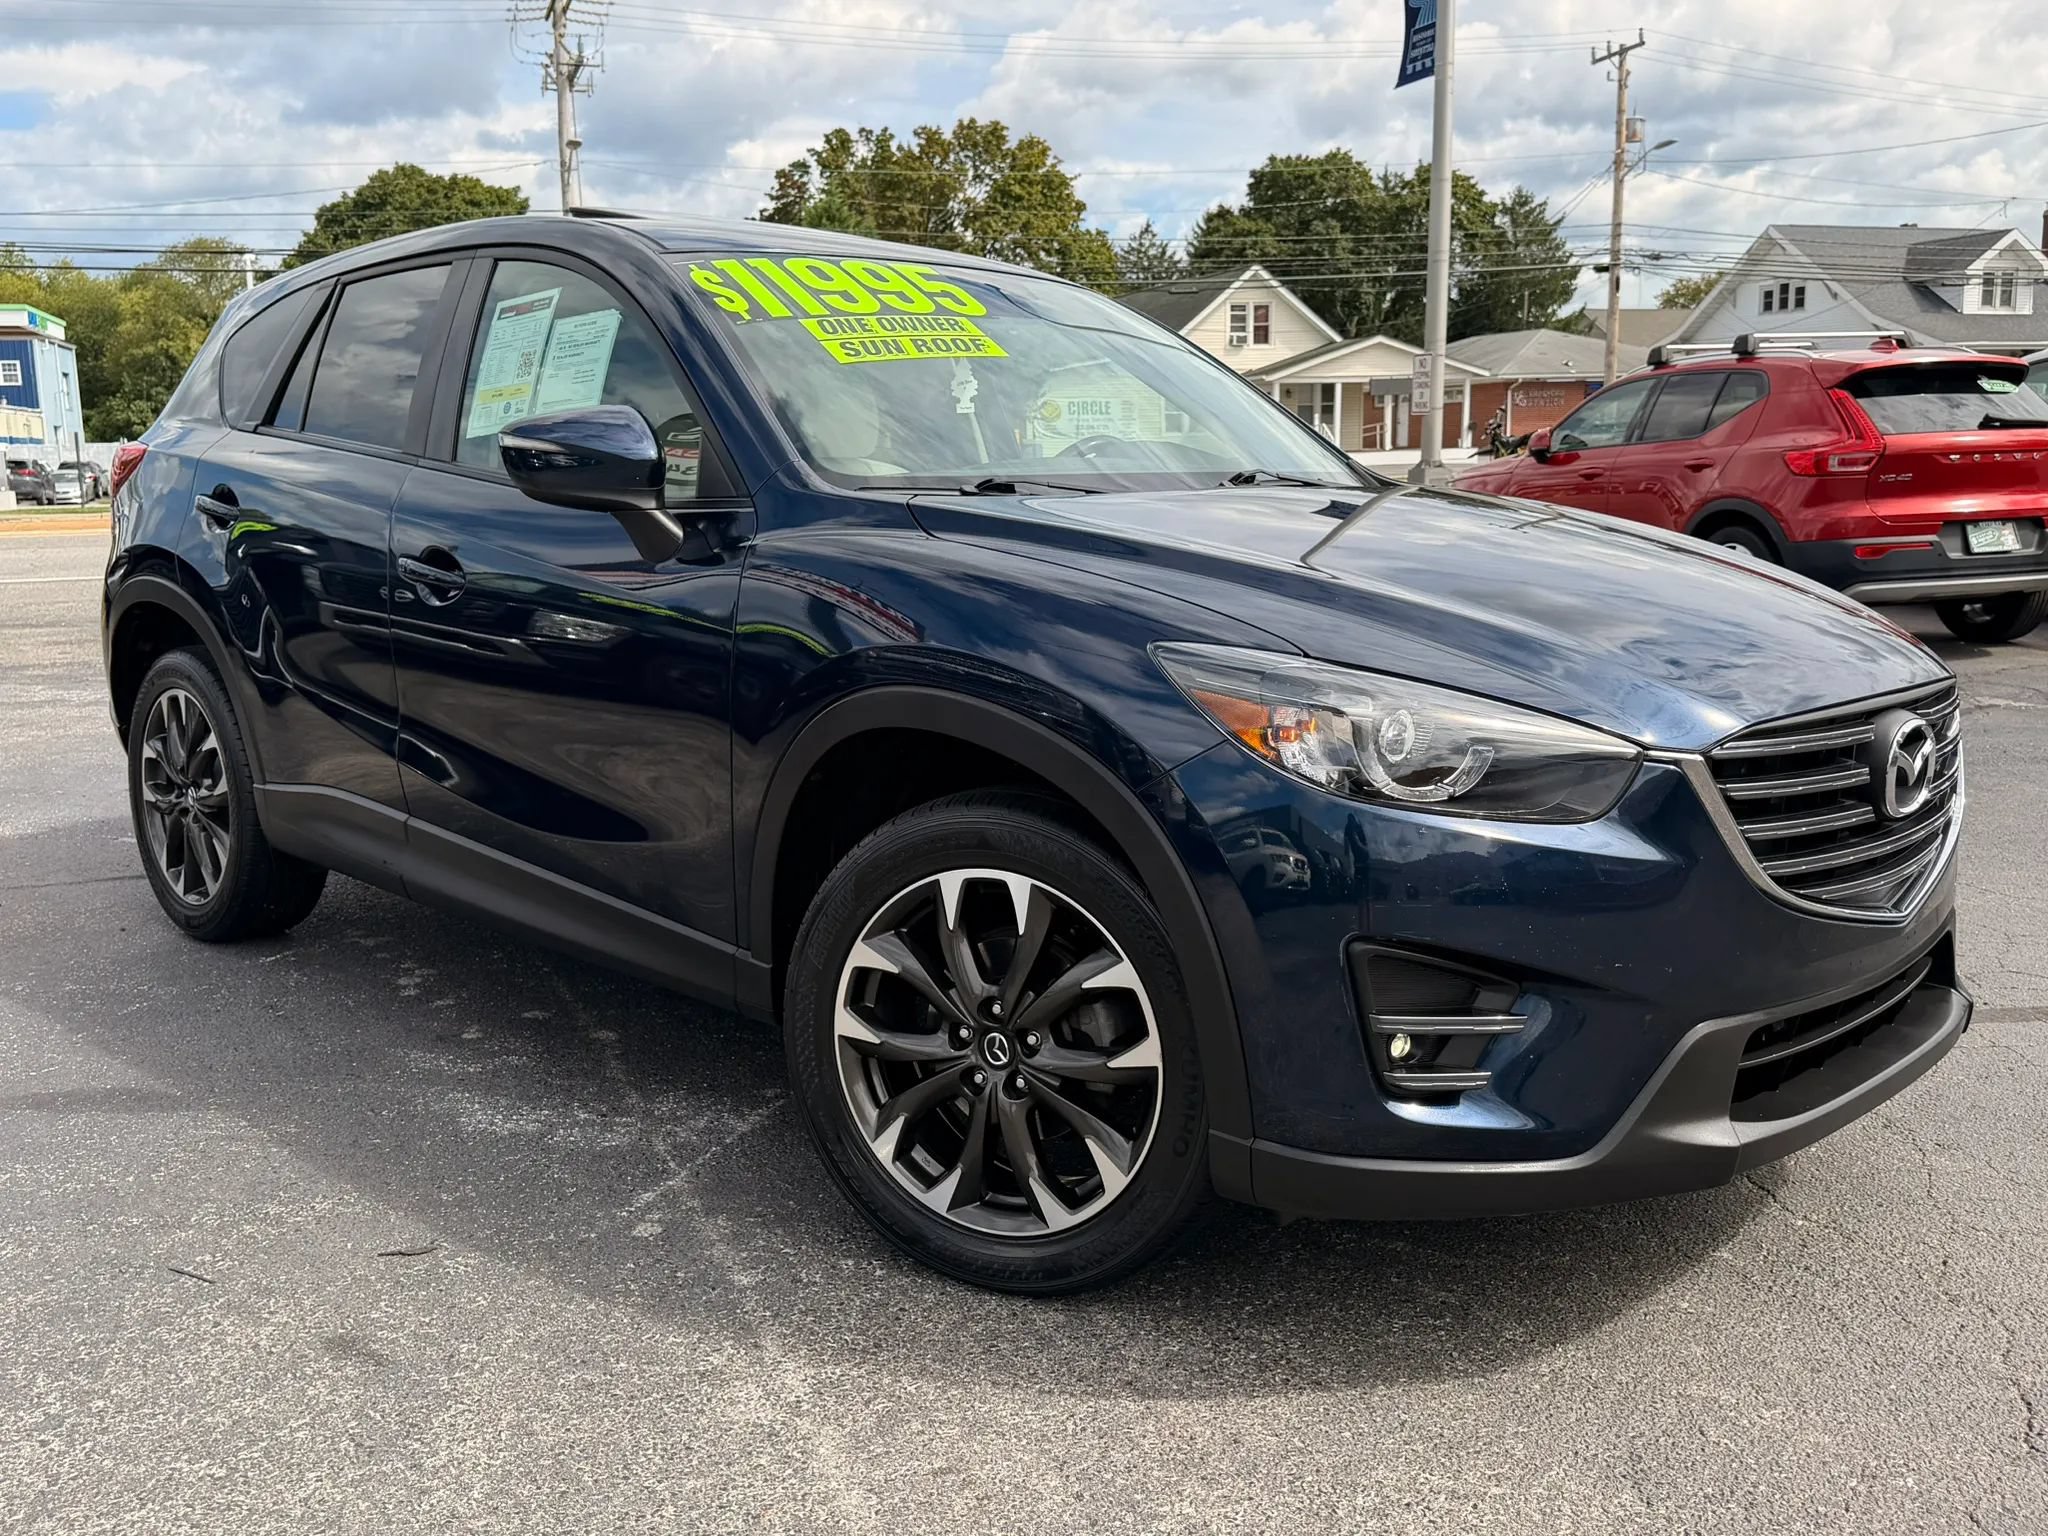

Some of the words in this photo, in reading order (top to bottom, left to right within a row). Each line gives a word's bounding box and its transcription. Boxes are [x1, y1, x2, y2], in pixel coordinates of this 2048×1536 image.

[689, 257, 987, 320] $11995
[820, 317, 876, 336] ONE
[879, 316, 968, 334] OWNER
[840, 338, 908, 358] SUN
[916, 336, 989, 355] ROOF
[1067, 399, 1112, 416] CIRCLE
